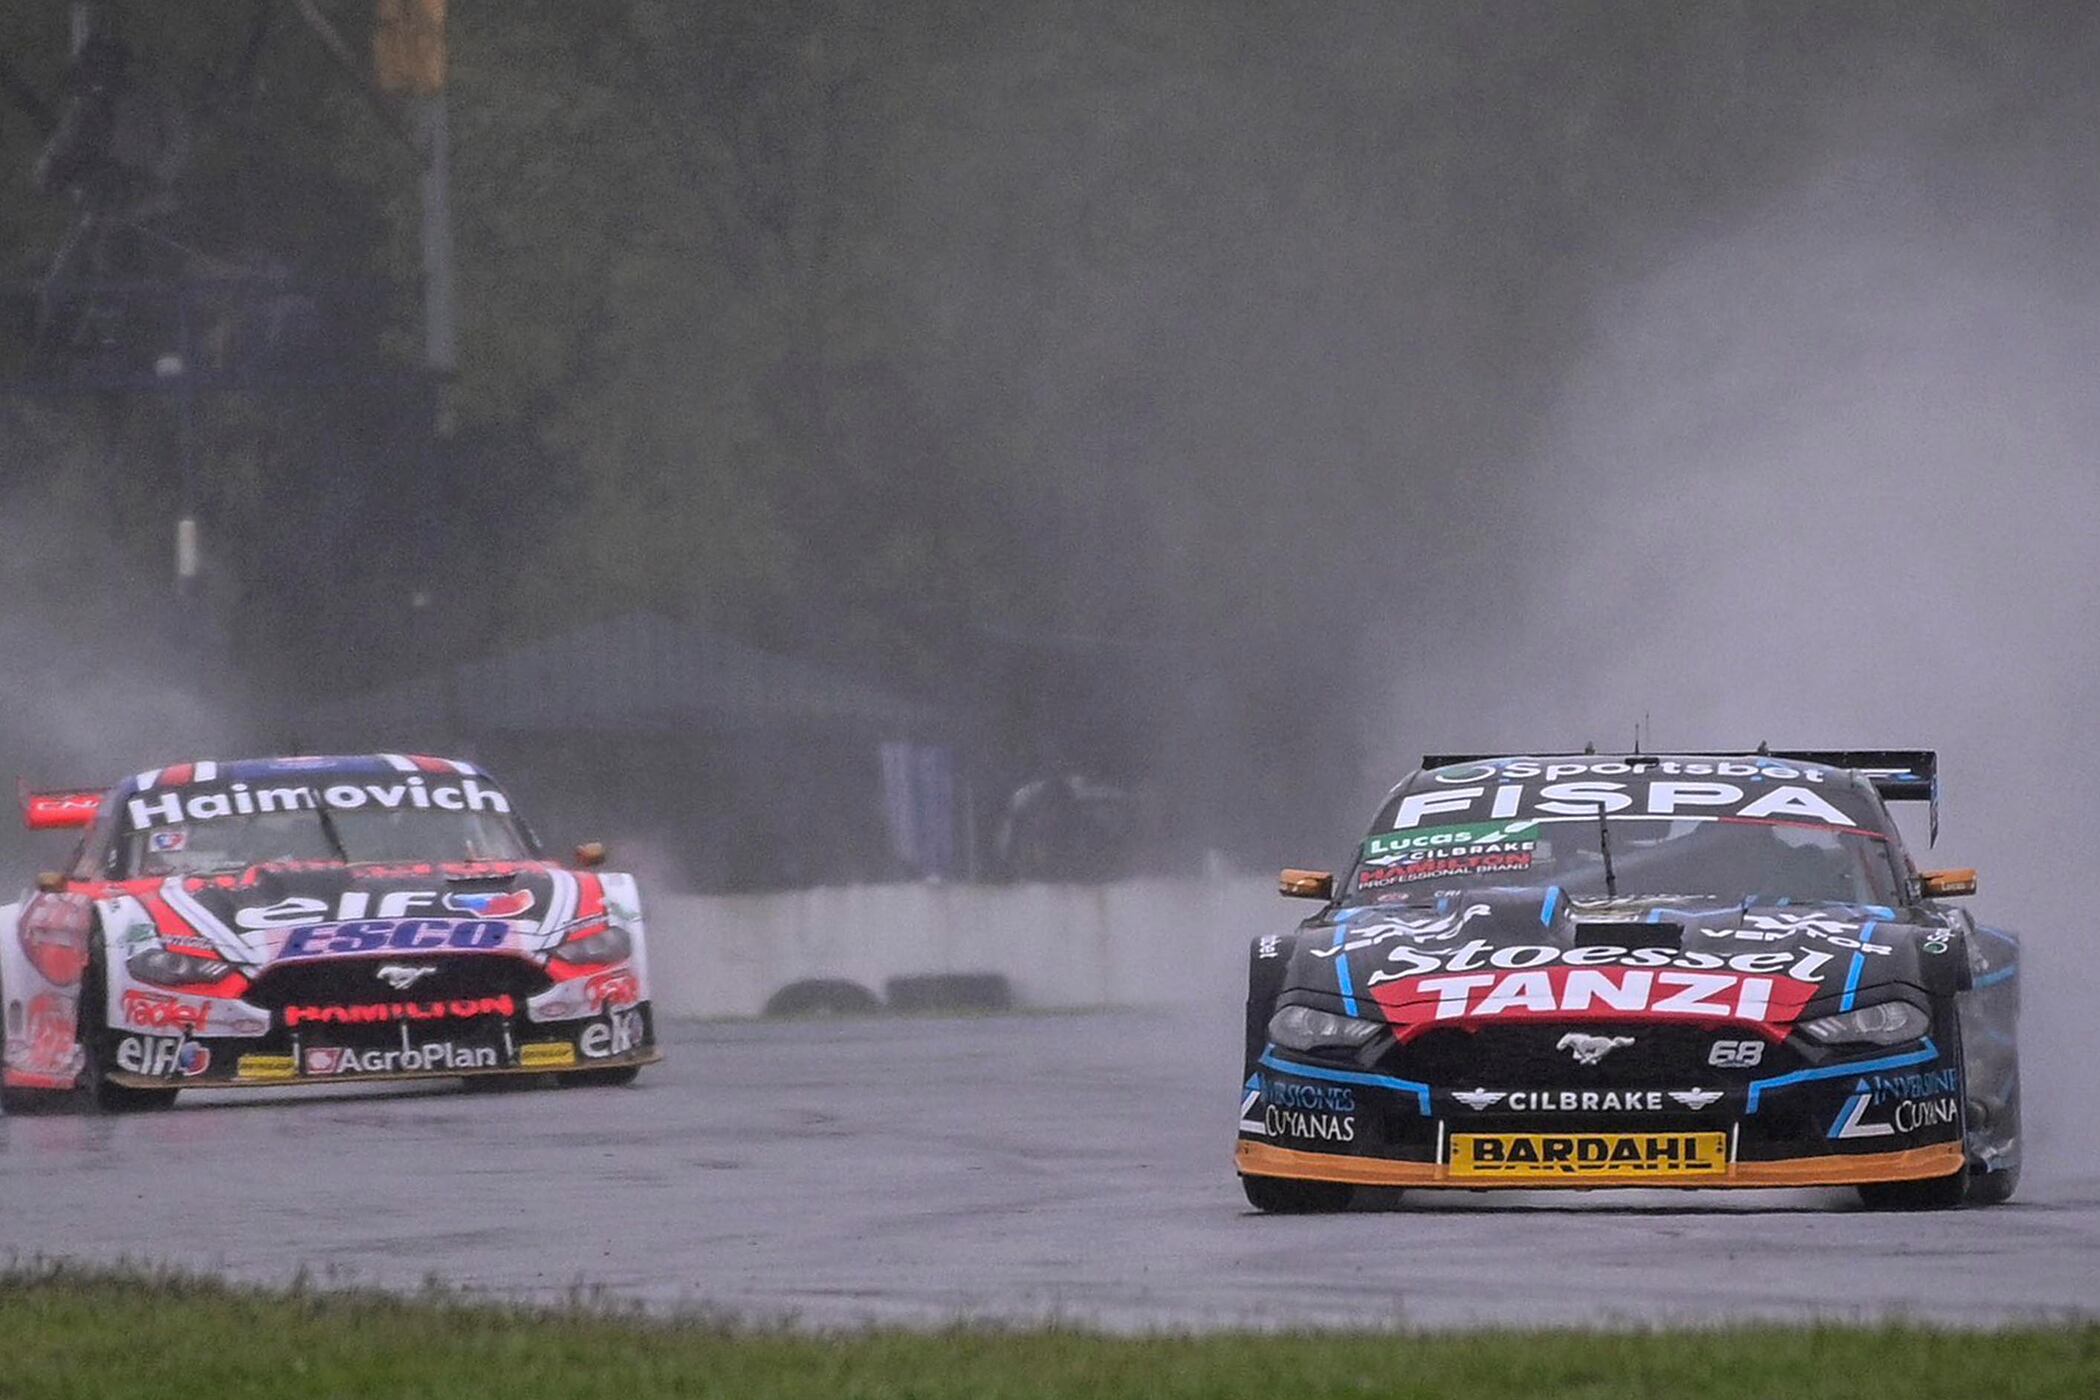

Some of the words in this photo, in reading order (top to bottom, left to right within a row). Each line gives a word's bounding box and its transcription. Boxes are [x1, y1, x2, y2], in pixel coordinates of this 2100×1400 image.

[127, 776, 511, 830] Haimovich
[1392, 781, 1857, 830] FISPA
[1371, 831, 1473, 855] Lucas
[1410, 841, 1535, 861] CILBRAKE
[1358, 867, 1472, 891] PROFESSIONAL
[1475, 863, 1530, 875] BRAND
[1368, 940, 1834, 986] Stoessel
[1416, 970, 1773, 1022] TANZI
[336, 1042, 497, 1074] AgroPlan
[1708, 1040, 1765, 1067] 68
[1508, 1091, 1664, 1111] CILBRAKE
[1265, 1104, 1356, 1142] CUYANAS
[1473, 1137, 1713, 1173] BARDAHL
